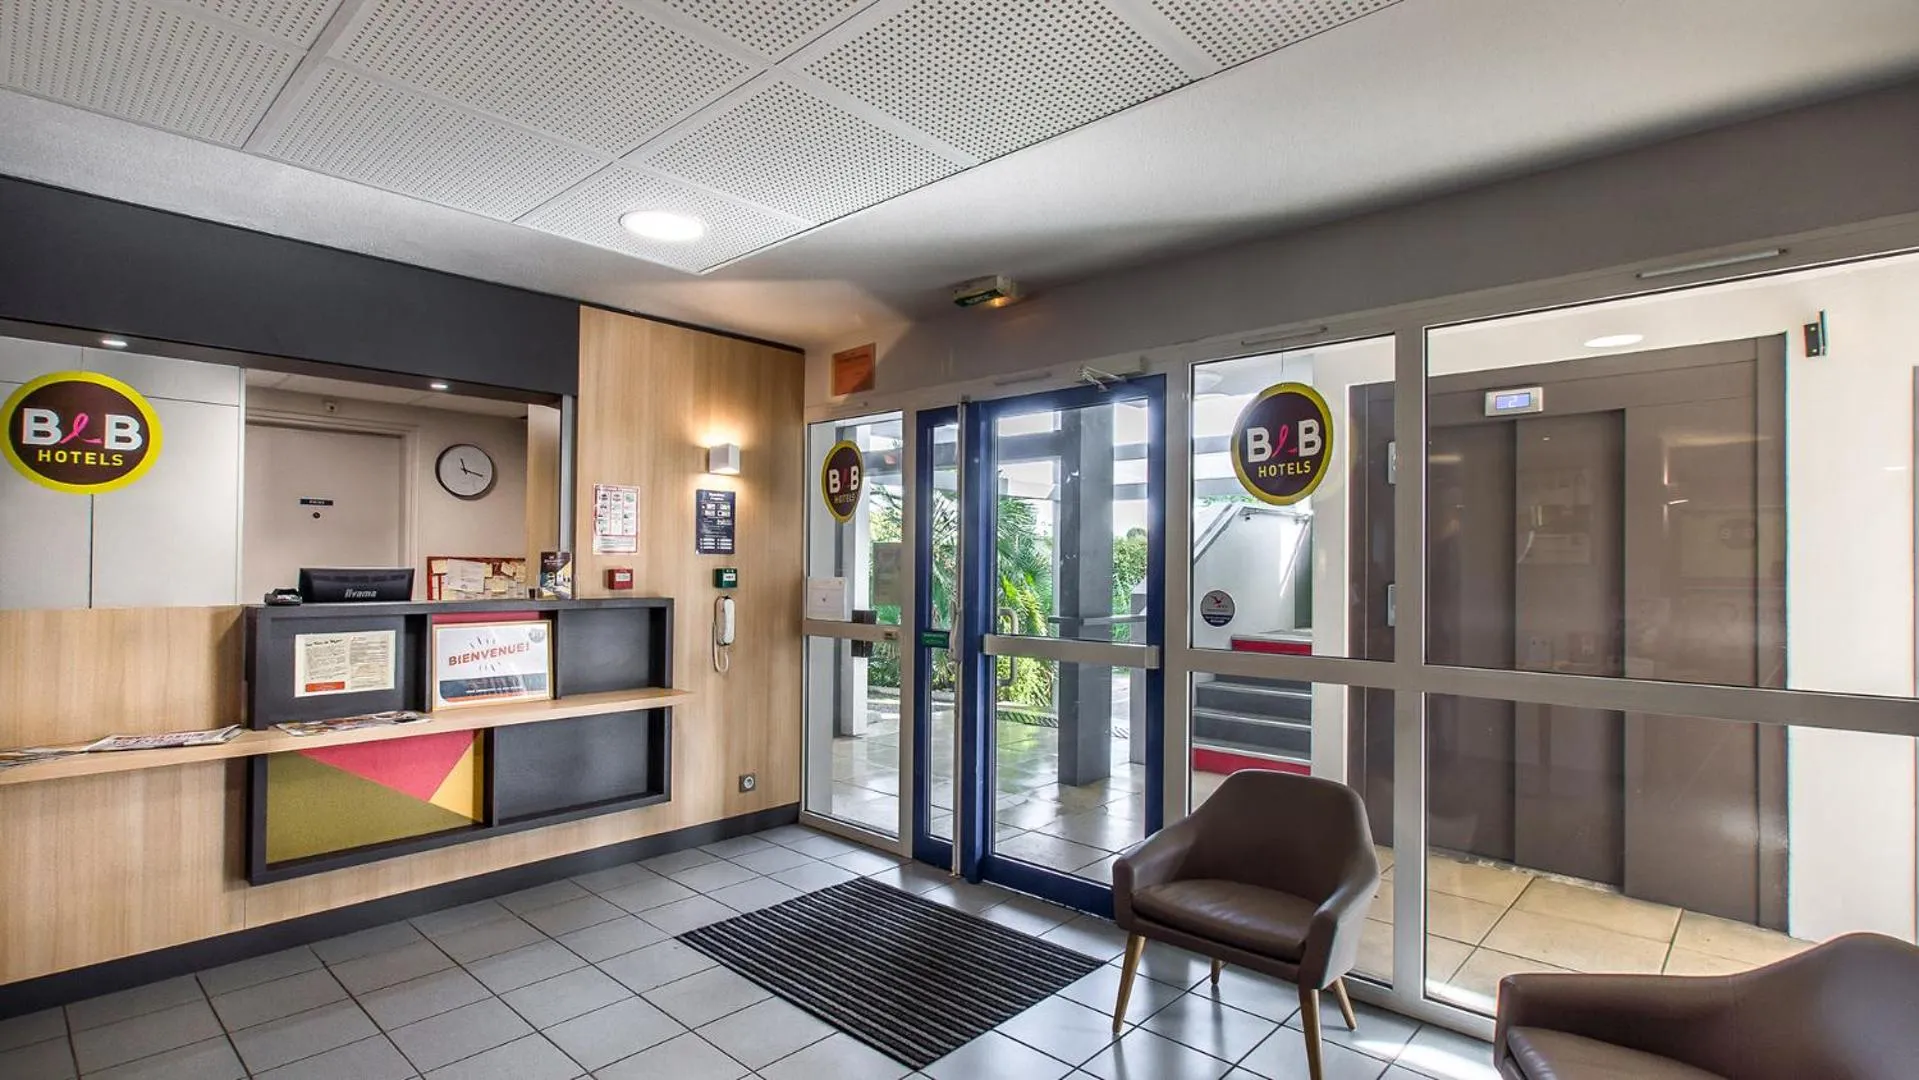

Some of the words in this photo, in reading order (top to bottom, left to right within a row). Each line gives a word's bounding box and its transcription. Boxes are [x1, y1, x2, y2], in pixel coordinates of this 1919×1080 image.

[38, 449, 124, 467] HOTELS
[1258, 460, 1312, 478] HOTELS
[448, 641, 530, 667] BIENVENUE!
